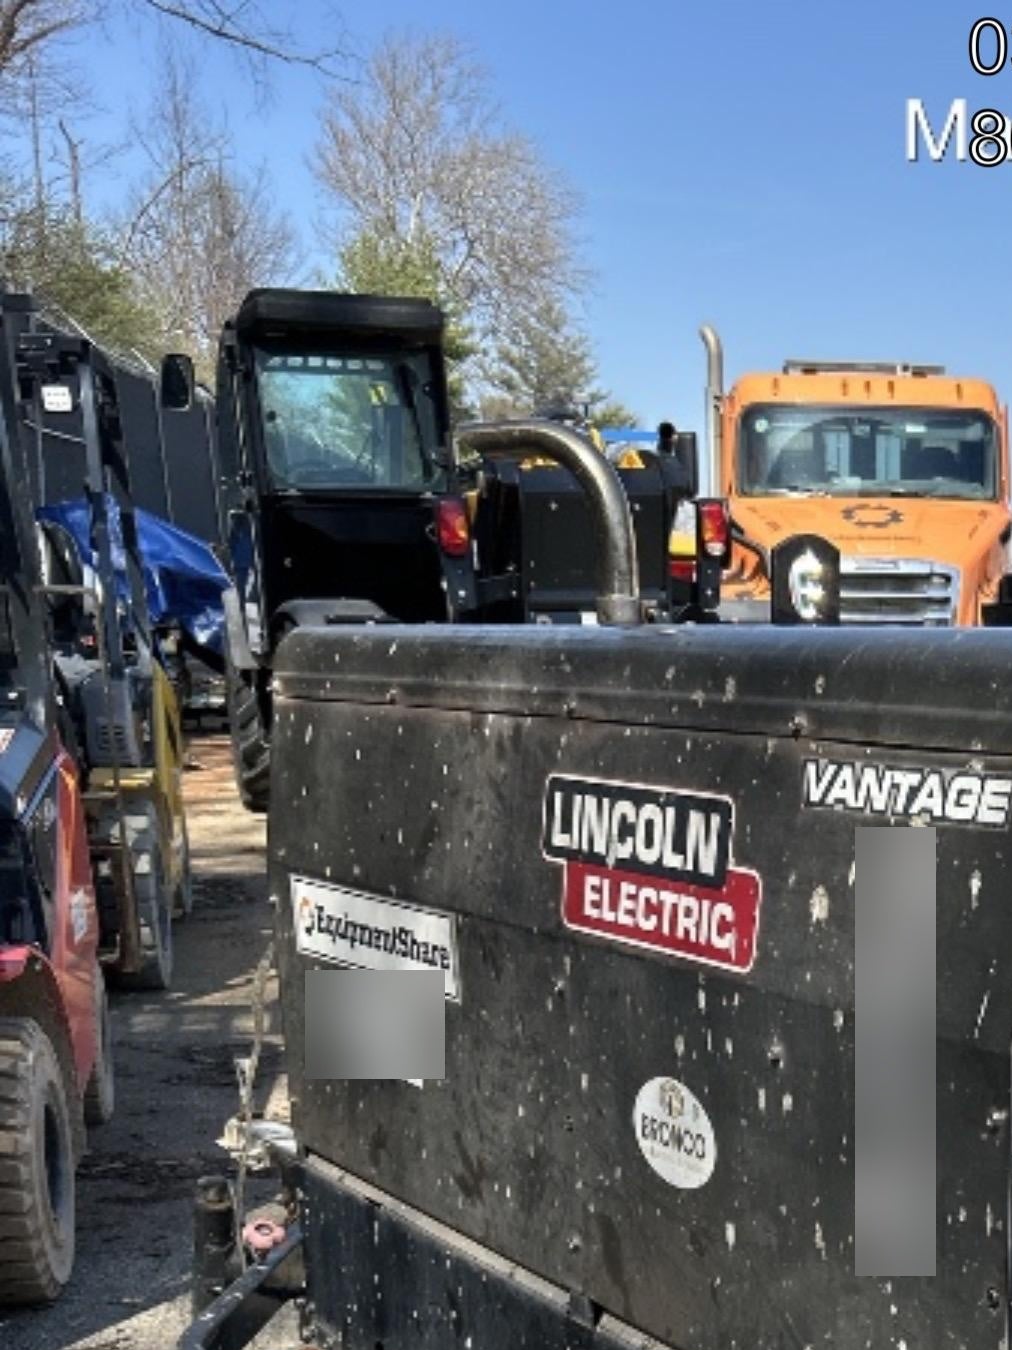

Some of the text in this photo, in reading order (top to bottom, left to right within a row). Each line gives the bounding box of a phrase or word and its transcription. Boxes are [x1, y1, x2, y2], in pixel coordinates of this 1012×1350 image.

[551, 791, 721, 878] LINCOLN
[315, 903, 451, 970] EquipmentShare
[583, 874, 737, 951] ELECTRIC
[641, 1112, 706, 1159] BRONCO
